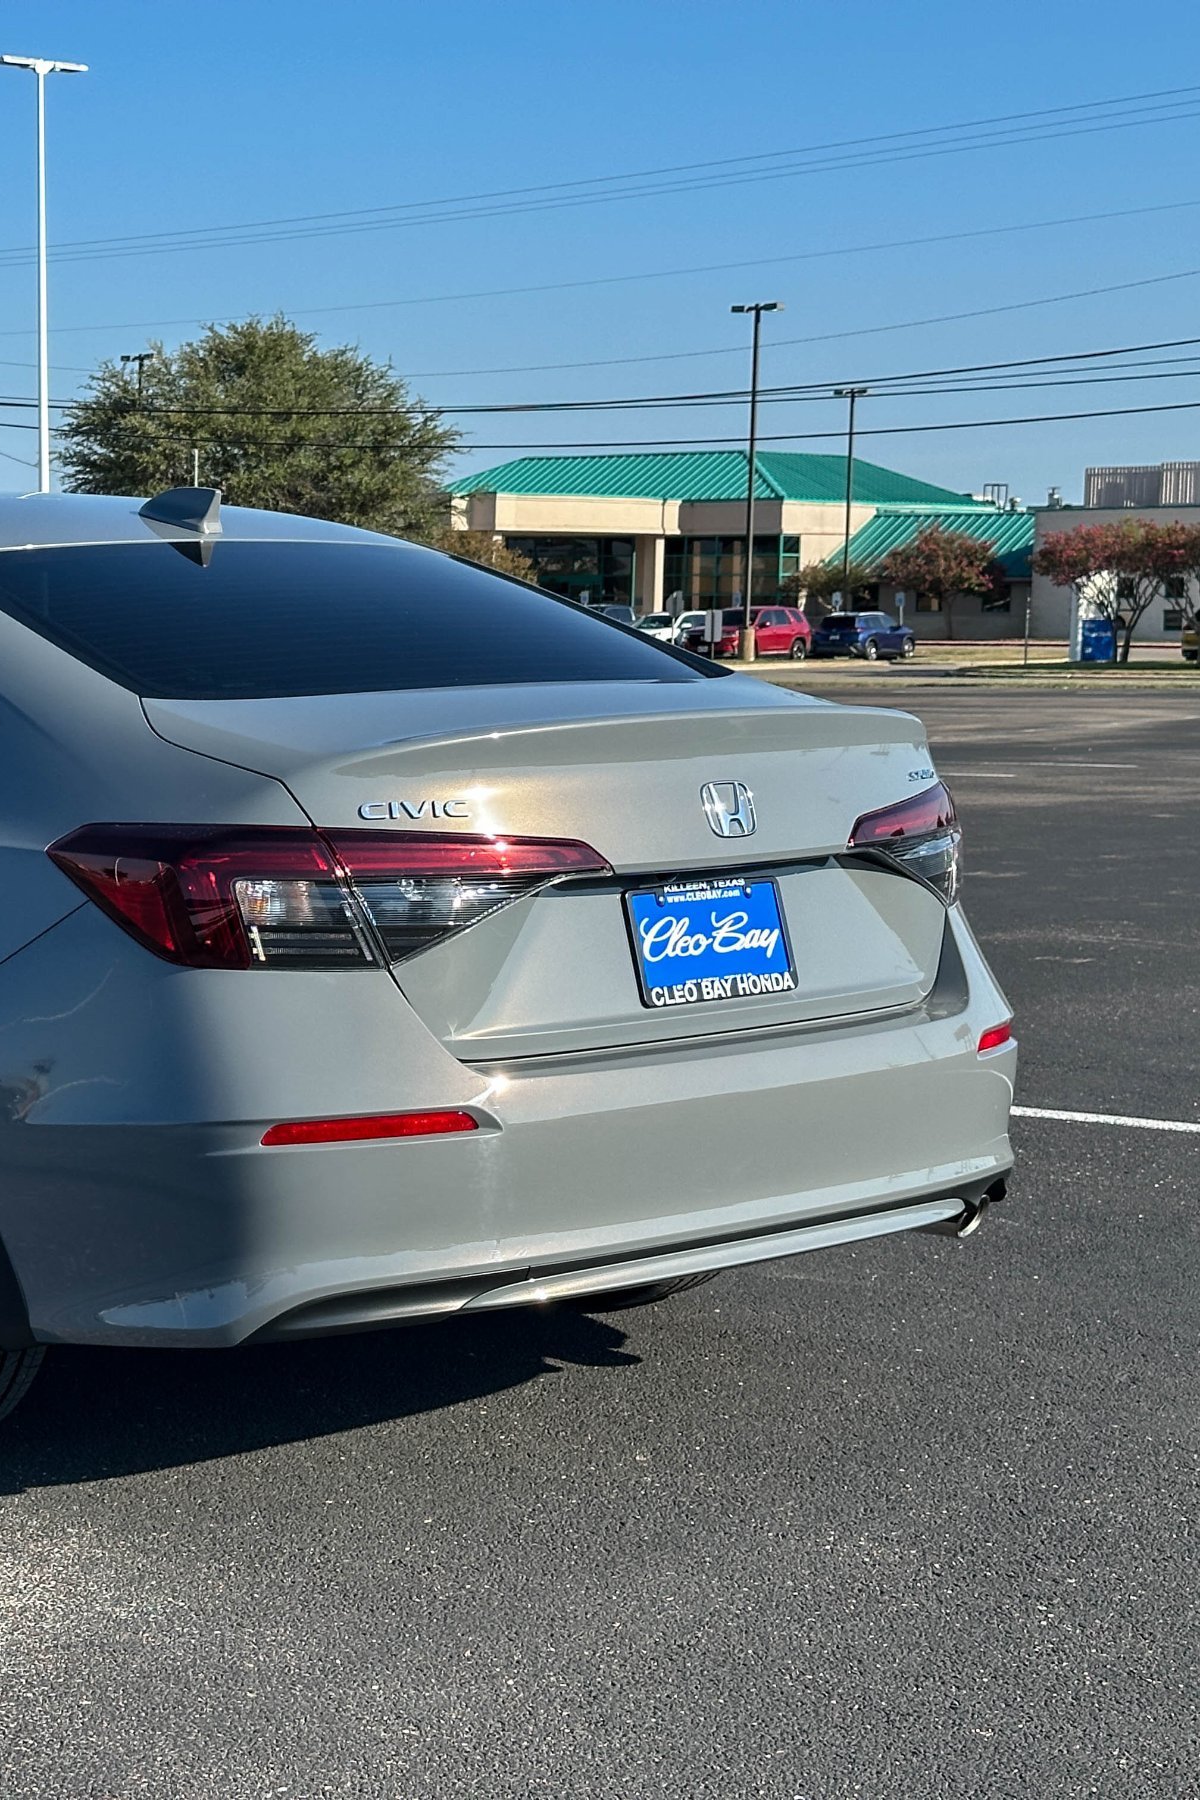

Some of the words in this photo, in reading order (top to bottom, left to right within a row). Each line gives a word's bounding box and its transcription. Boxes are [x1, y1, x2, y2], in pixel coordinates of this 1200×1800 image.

[357, 800, 471, 820] CIVIC
[664, 882, 711, 894] KILLEEN,
[713, 878, 746, 889] TEXAS
[666, 889, 741, 904] www.CLEOBAY.com
[640, 916, 712, 962] Cleo
[711, 912, 779, 958] Bay
[651, 983, 697, 1007] CLEO
[701, 979, 732, 1000] BAY
[737, 973, 795, 995] HONDA
